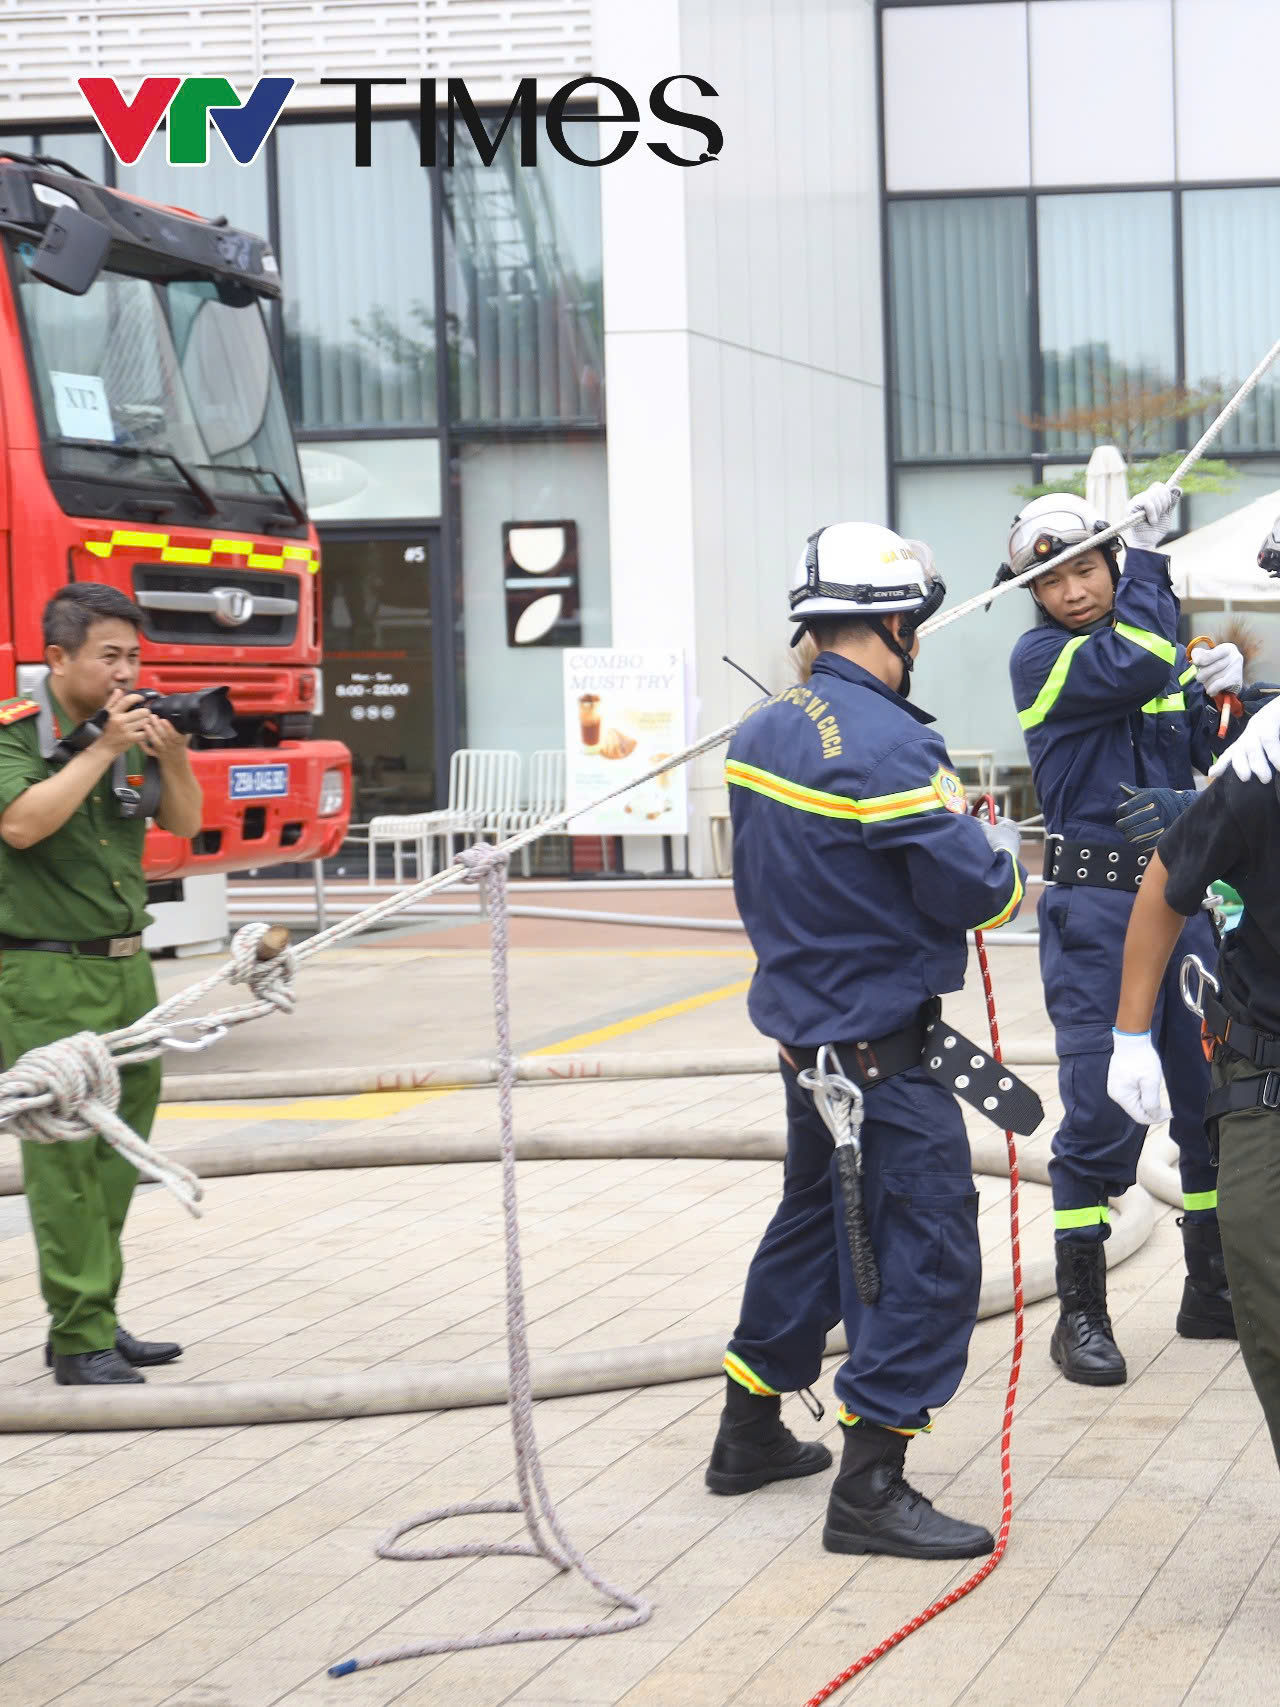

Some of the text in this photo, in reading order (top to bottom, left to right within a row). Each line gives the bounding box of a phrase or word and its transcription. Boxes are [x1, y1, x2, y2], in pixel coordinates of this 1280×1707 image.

[569, 654, 643, 670] COMBO
[569, 674, 675, 690] MUST TRY
[816, 715, 842, 759] CNCH
